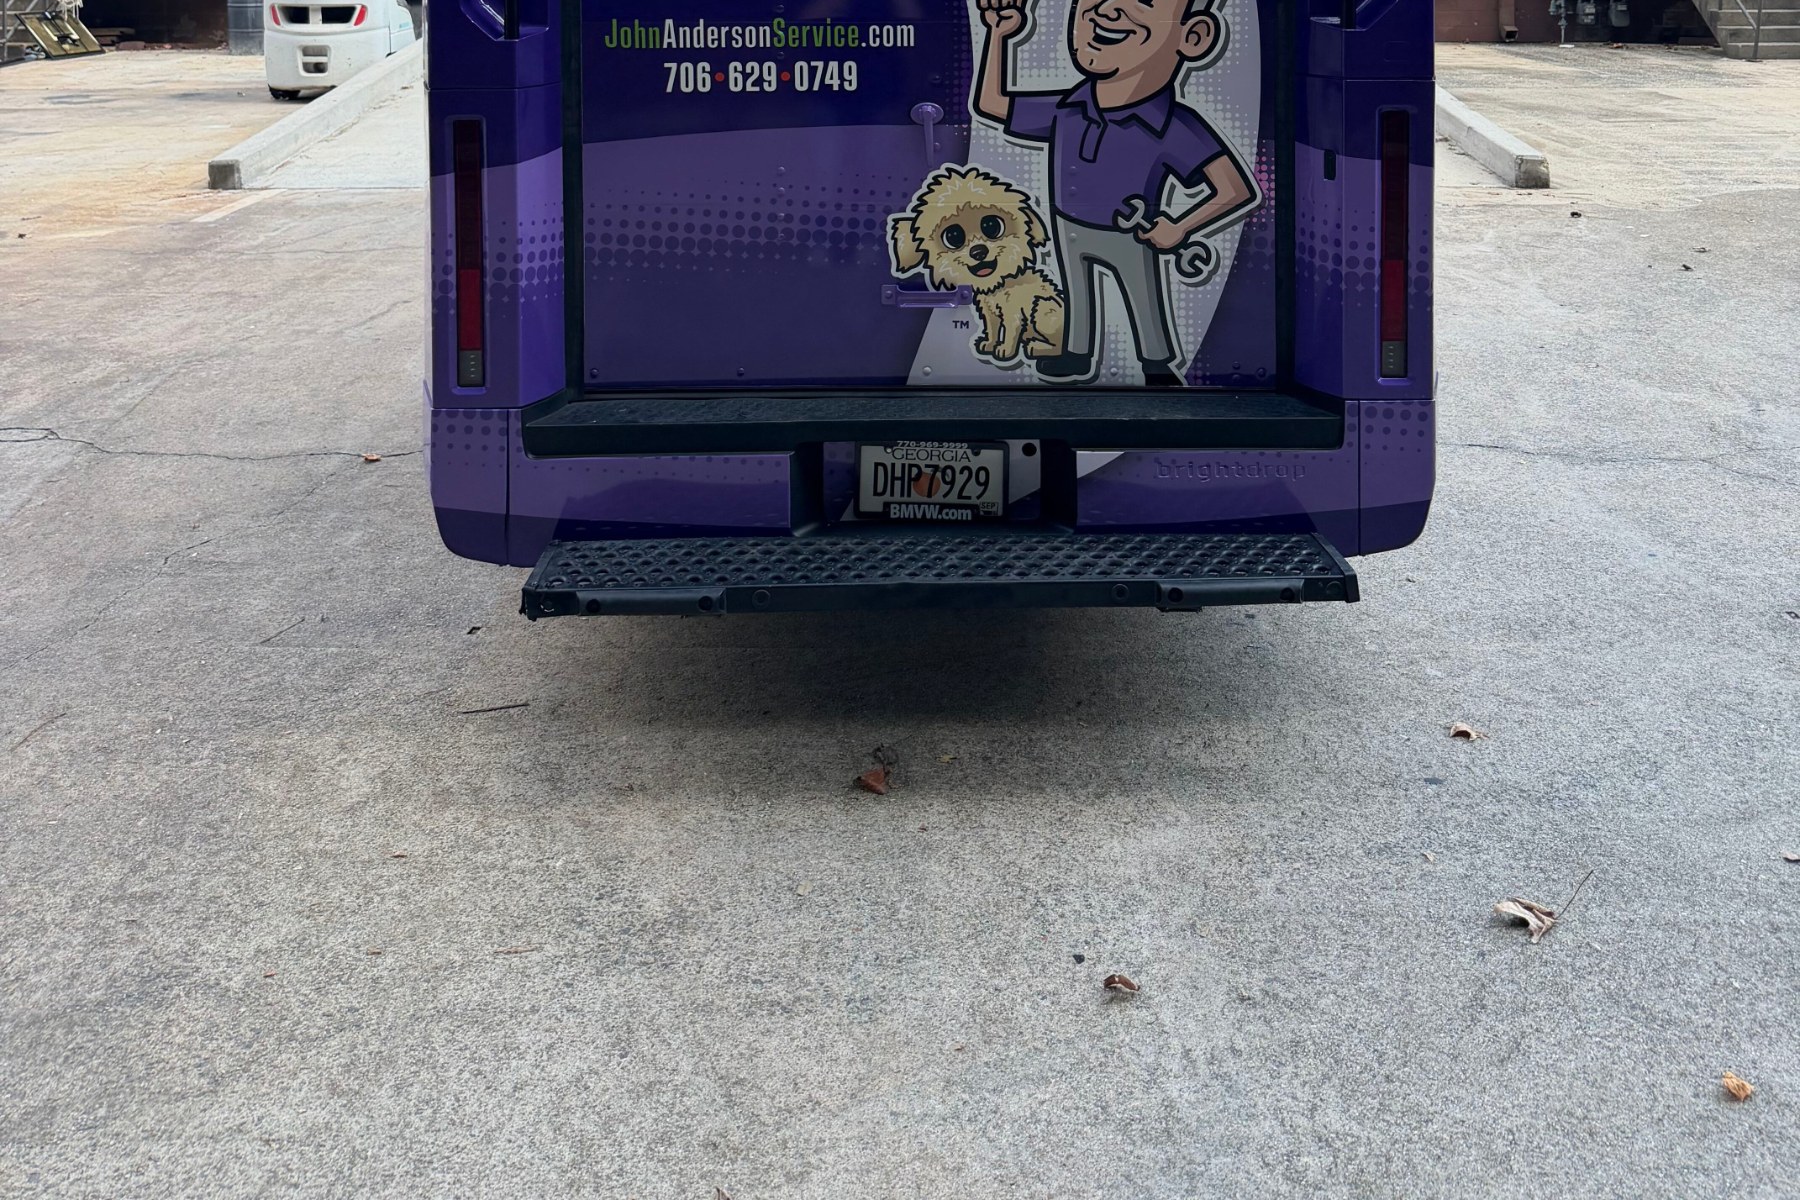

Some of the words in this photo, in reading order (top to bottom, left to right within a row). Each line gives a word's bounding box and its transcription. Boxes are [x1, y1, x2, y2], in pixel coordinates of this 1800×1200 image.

[604, 17, 915, 49] JohnAndersonService.com
[897, 440, 968, 449] 770-969-9999
[892, 448, 972, 463] GEORGIA
[1155, 460, 1306, 483] brightdrop
[872, 461, 990, 501] DHP7929
[889, 503, 973, 521] BMVW.com
[980, 501, 996, 510] SEP
